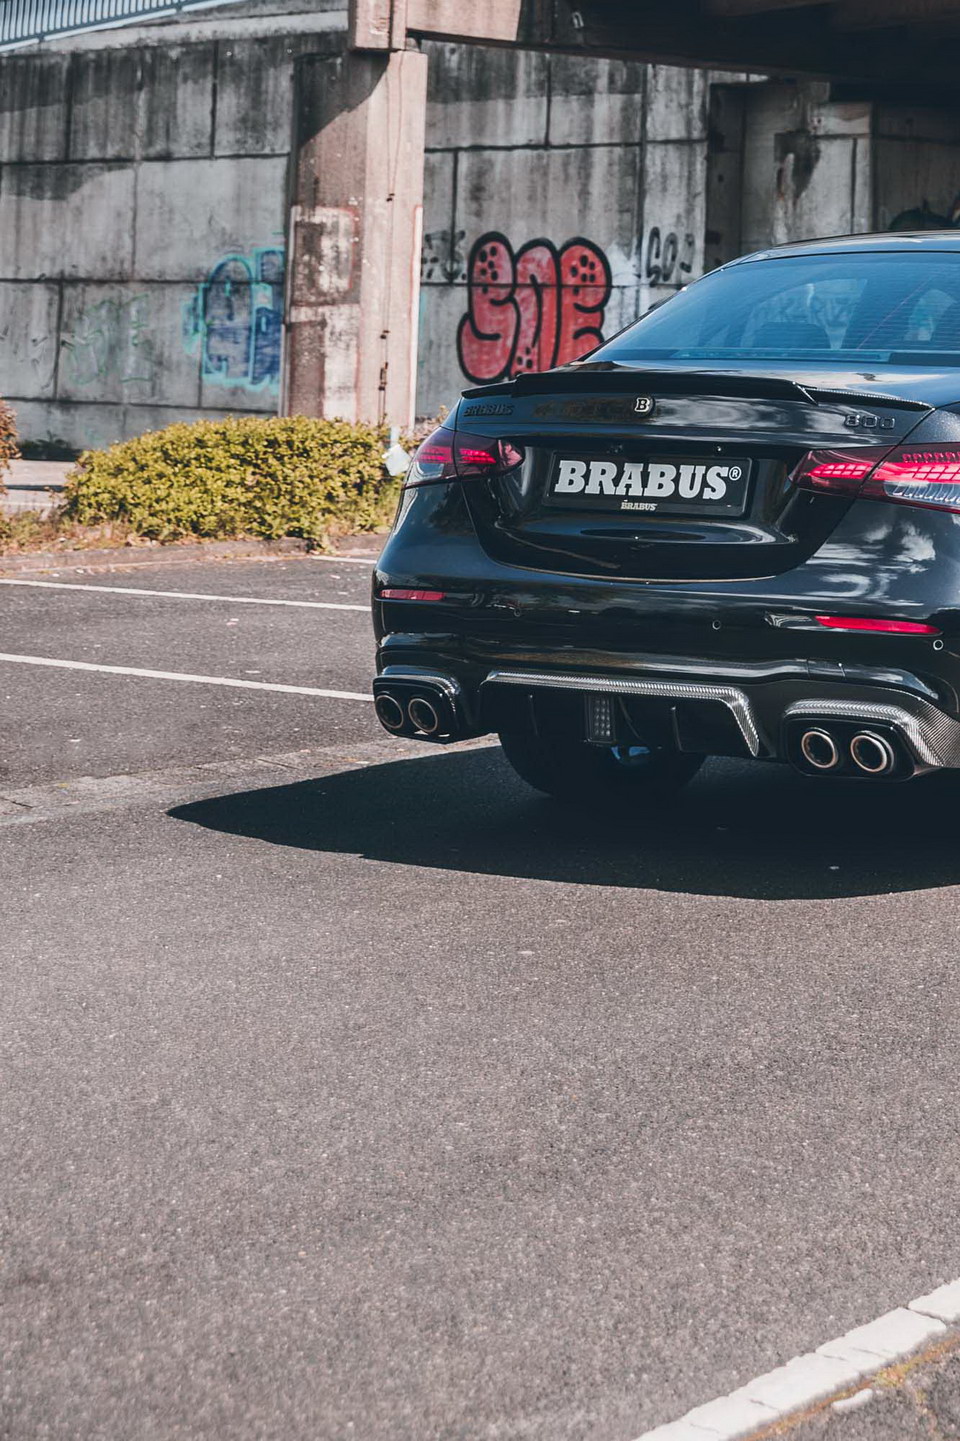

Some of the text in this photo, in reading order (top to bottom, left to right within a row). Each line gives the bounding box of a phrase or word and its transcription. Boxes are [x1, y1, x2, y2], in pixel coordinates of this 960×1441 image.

[634, 397, 651, 413] B
[845, 413, 896, 430] 800
[620, 501, 658, 511] BRABUS
